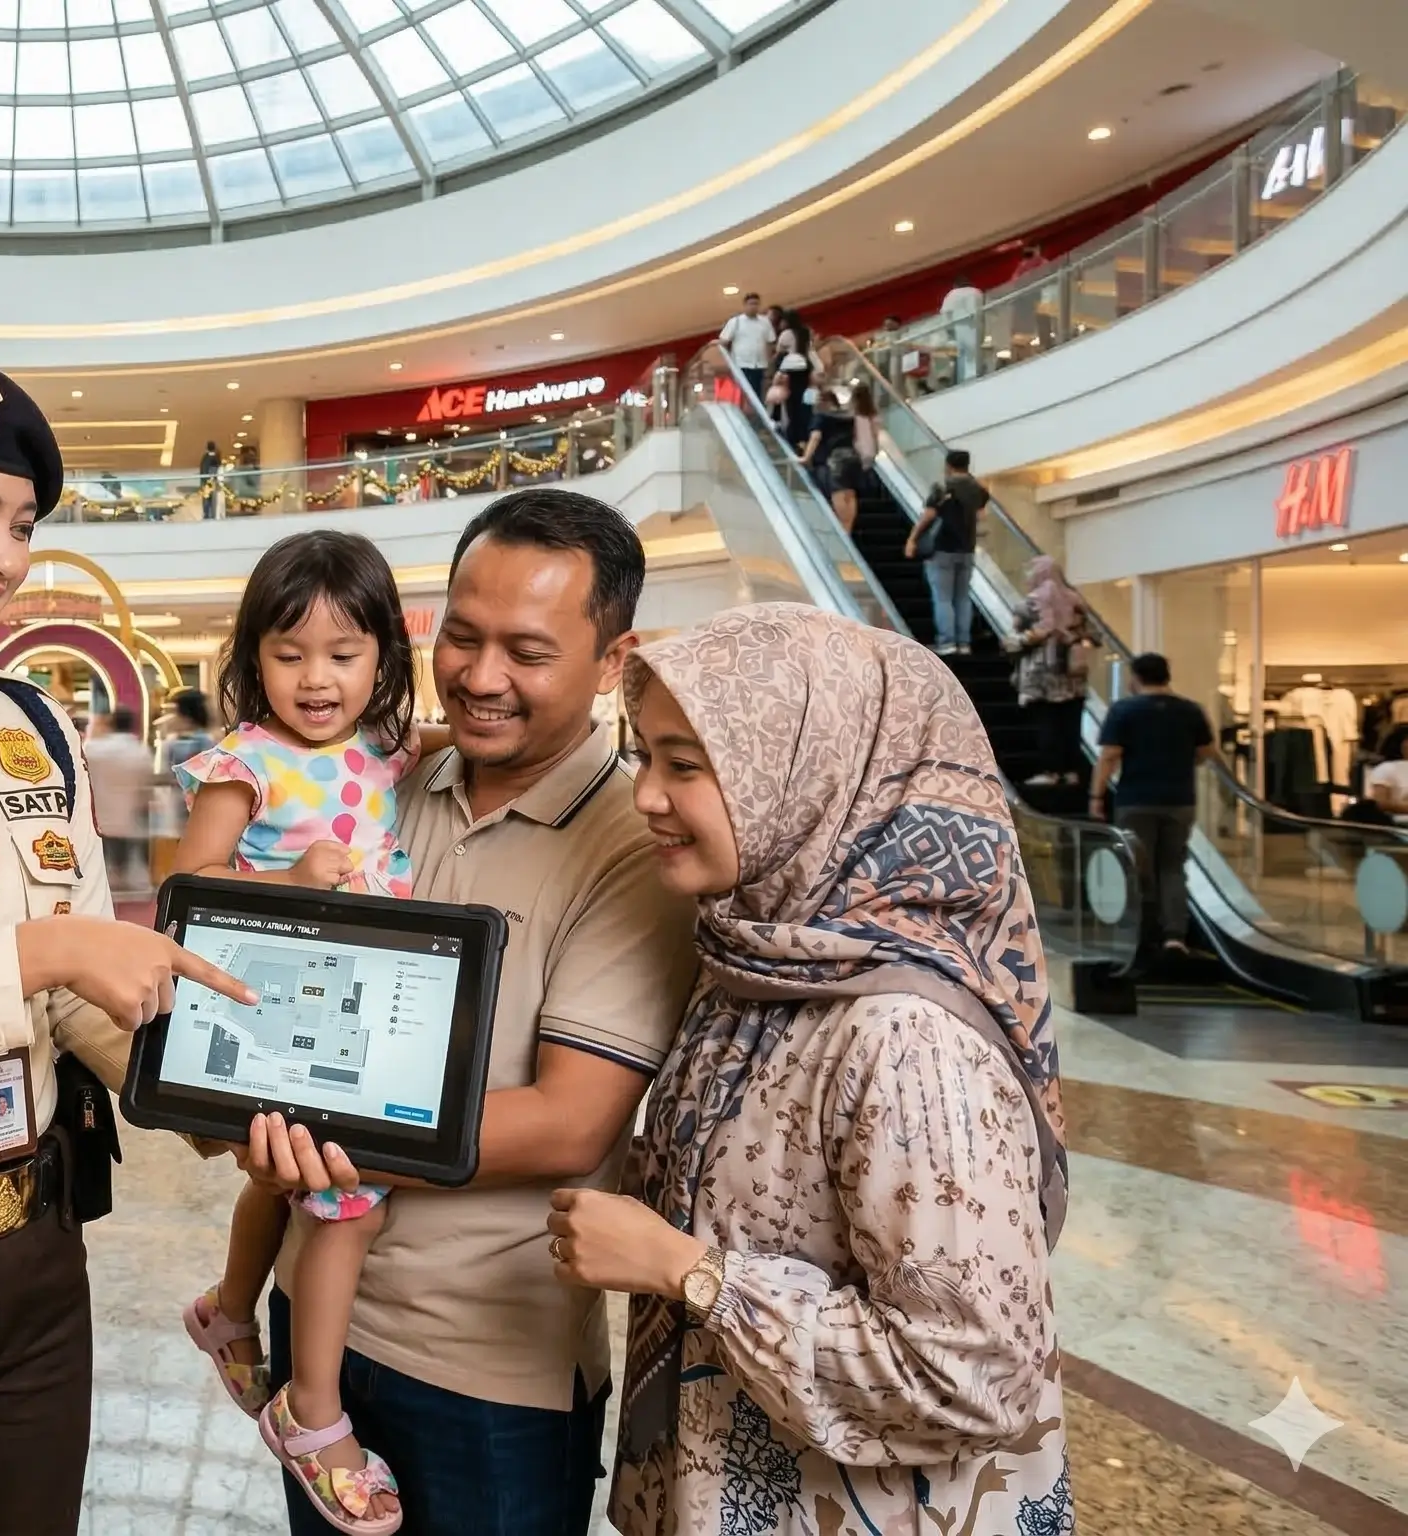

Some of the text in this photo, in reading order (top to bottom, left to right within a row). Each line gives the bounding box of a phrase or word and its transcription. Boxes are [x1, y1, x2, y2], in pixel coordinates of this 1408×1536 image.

[417, 386, 487, 422] ACE
[485, 376, 606, 412] Hardware
[5, 792, 67, 814] SATP
